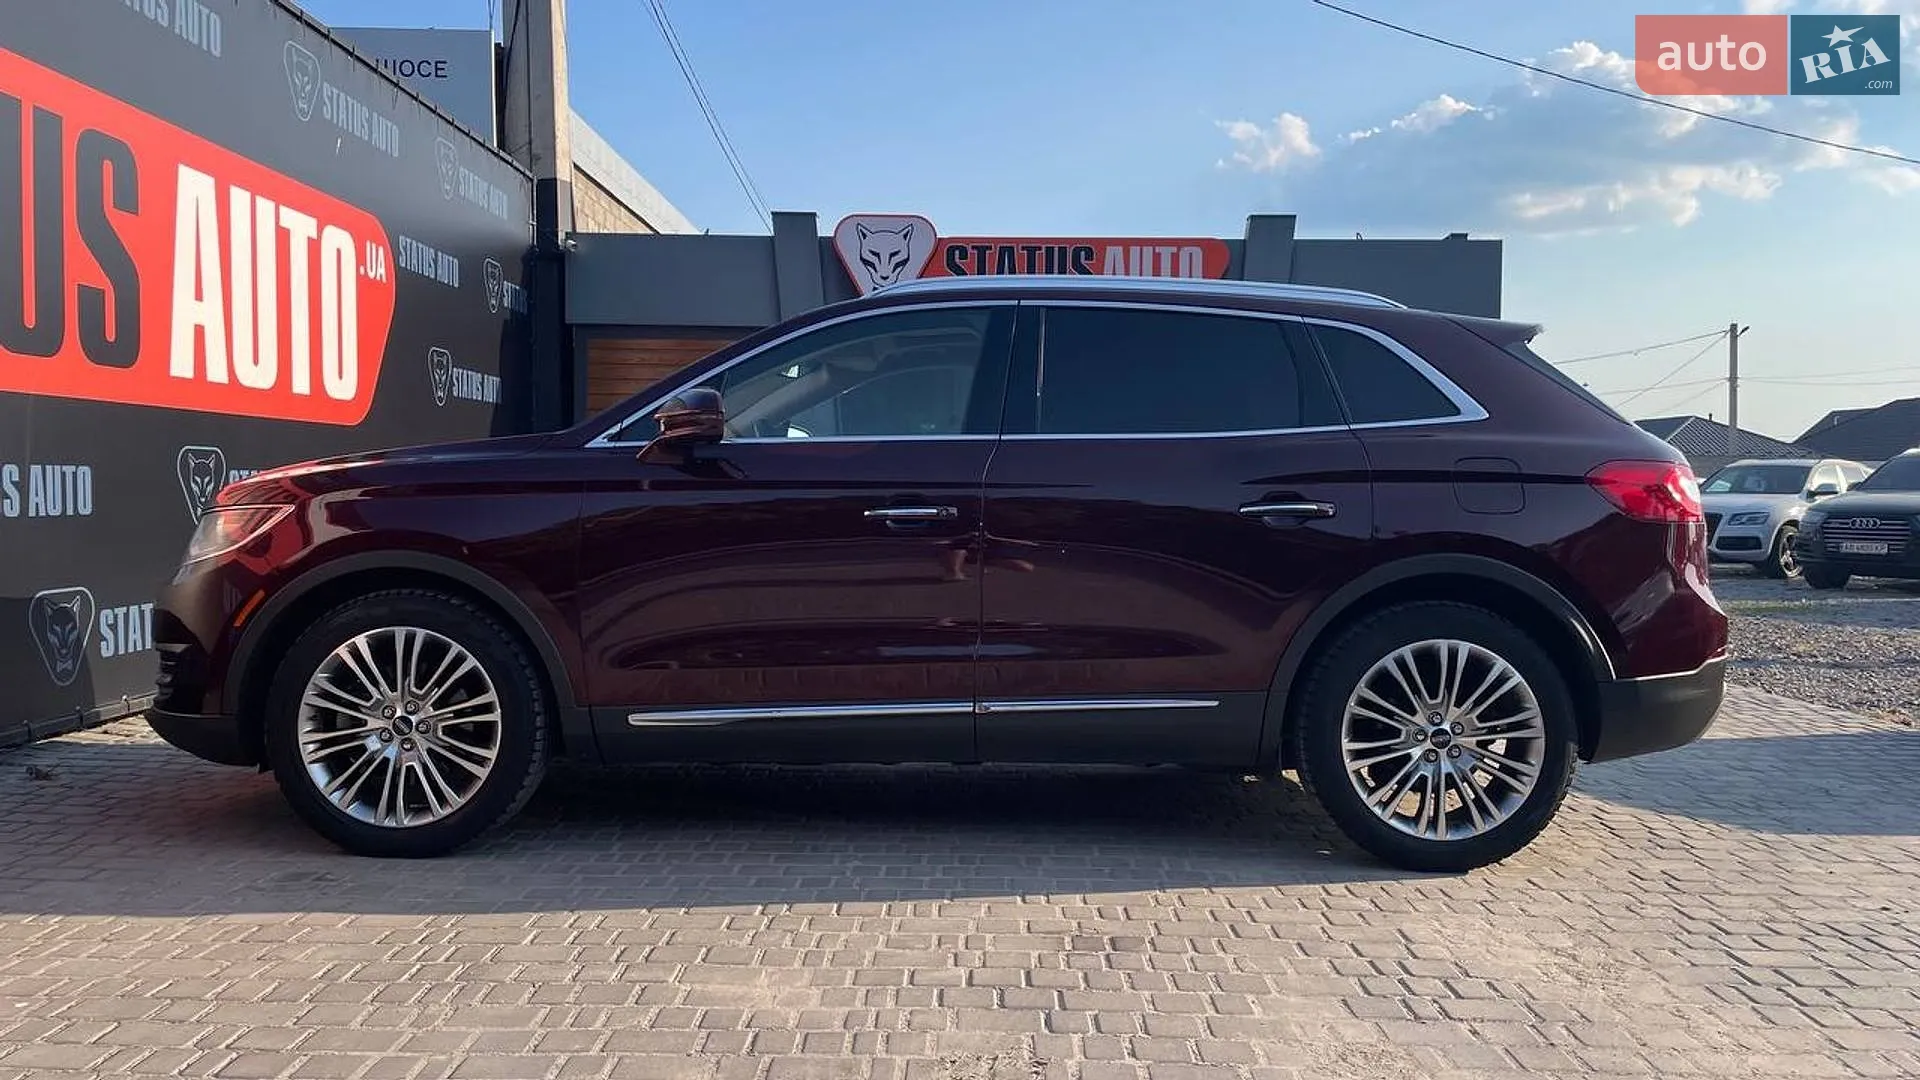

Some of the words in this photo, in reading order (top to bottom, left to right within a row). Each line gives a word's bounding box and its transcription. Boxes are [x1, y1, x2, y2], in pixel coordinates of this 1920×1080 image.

[174, 0, 221, 58] AUTO
[323, 81, 369, 141] STATUS
[371, 111, 399, 157] AUTO
[169, 163, 359, 401] AUTO
[399, 235, 435, 280] STATUS
[436, 250, 459, 289] AUTO
[452, 367, 482, 401] STATUS
[28, 463, 93, 518] AUTO
